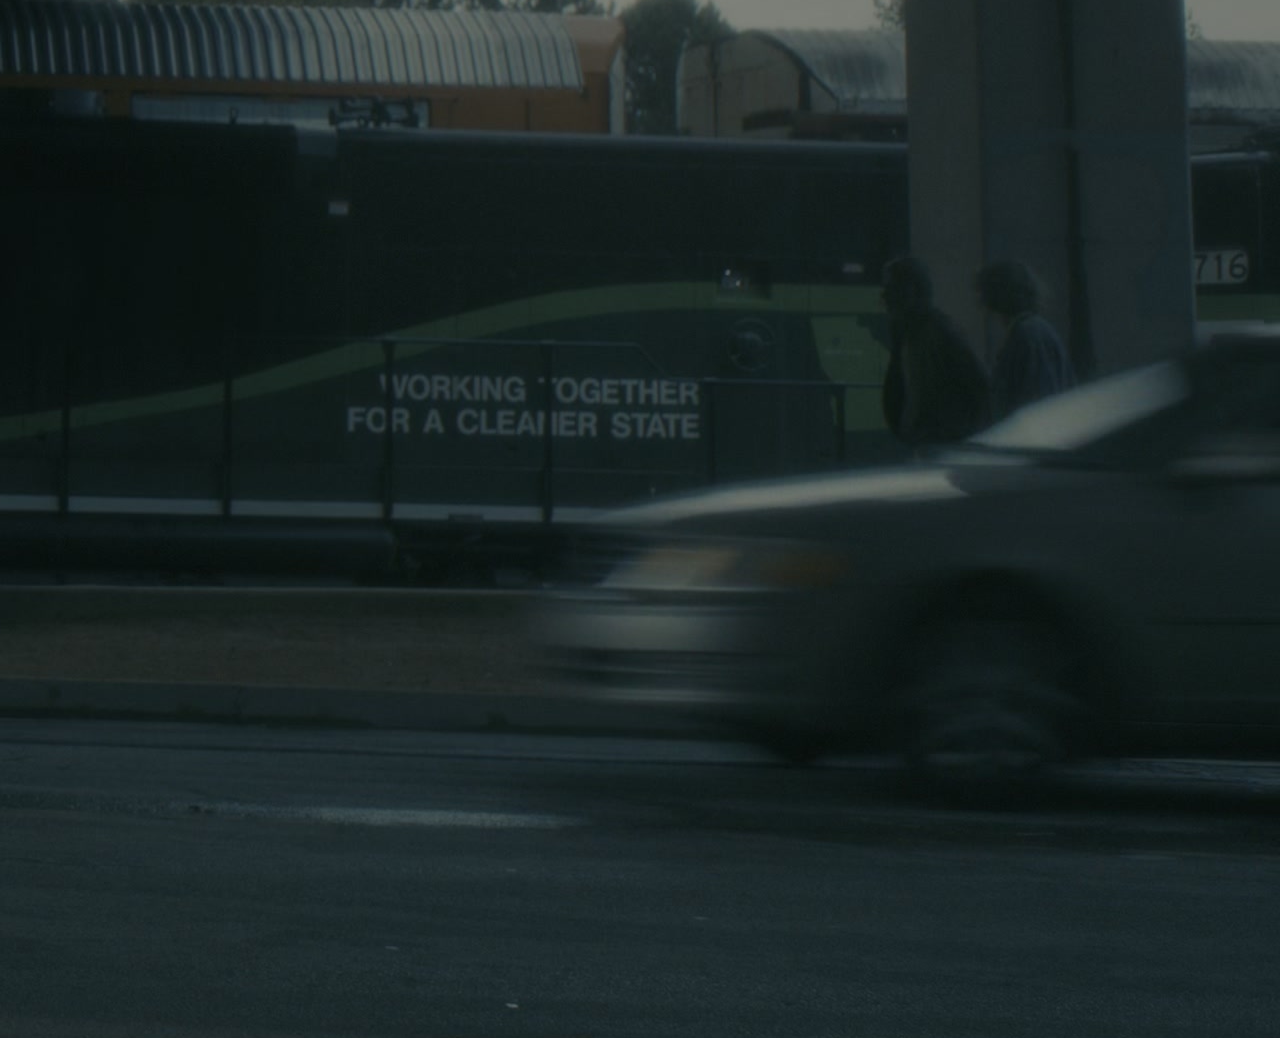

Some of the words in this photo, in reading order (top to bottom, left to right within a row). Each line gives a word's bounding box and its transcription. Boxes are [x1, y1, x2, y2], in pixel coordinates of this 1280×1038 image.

[1194, 252, 1248, 280] 716
[378, 372, 528, 403] WORKING
[537, 375, 701, 406] OGETHER
[346, 405, 411, 435] FOR
[421, 407, 446, 435] A
[455, 408, 599, 438] CLEANER
[609, 411, 702, 440] STATE
